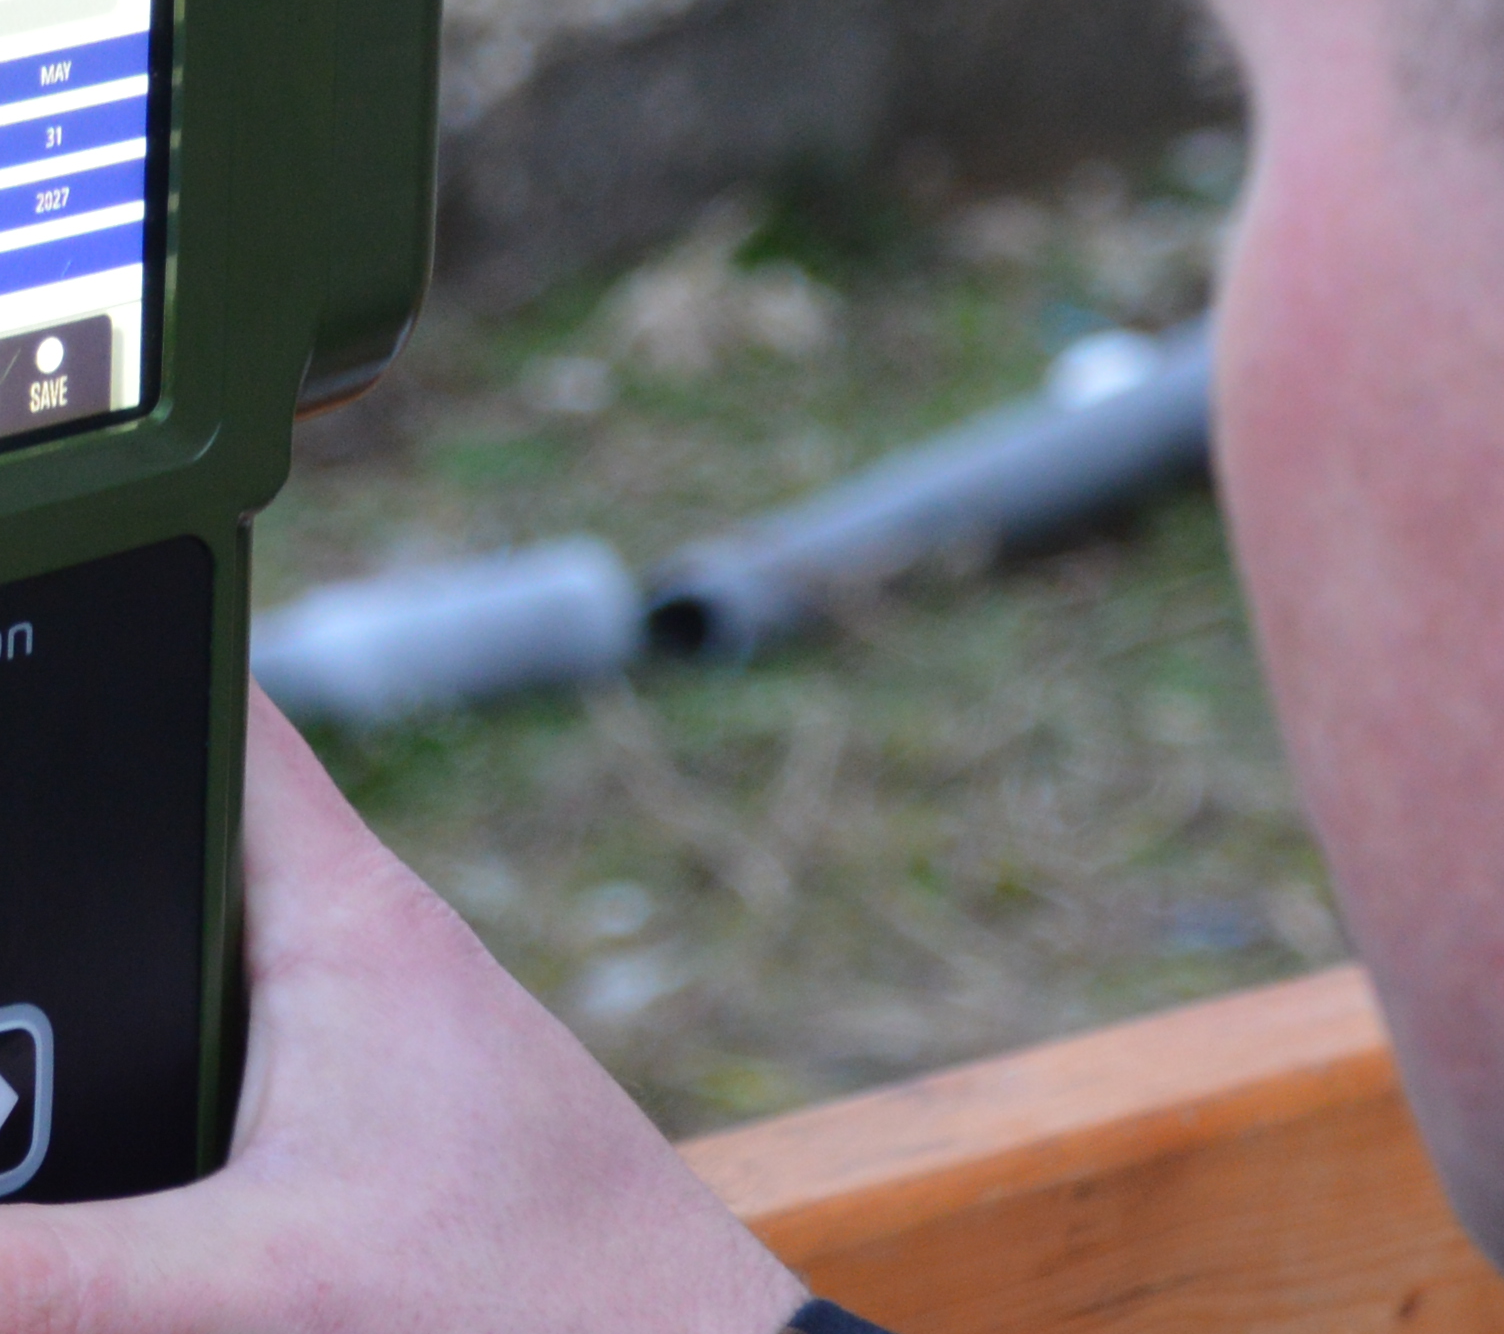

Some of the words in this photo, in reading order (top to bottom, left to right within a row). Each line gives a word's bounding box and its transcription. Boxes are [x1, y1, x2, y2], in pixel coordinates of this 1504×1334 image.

[40, 61, 74, 88] MAY
[45, 126, 62, 149] 31
[35, 186, 70, 214] 2027
[29, 375, 68, 411] SAVE
